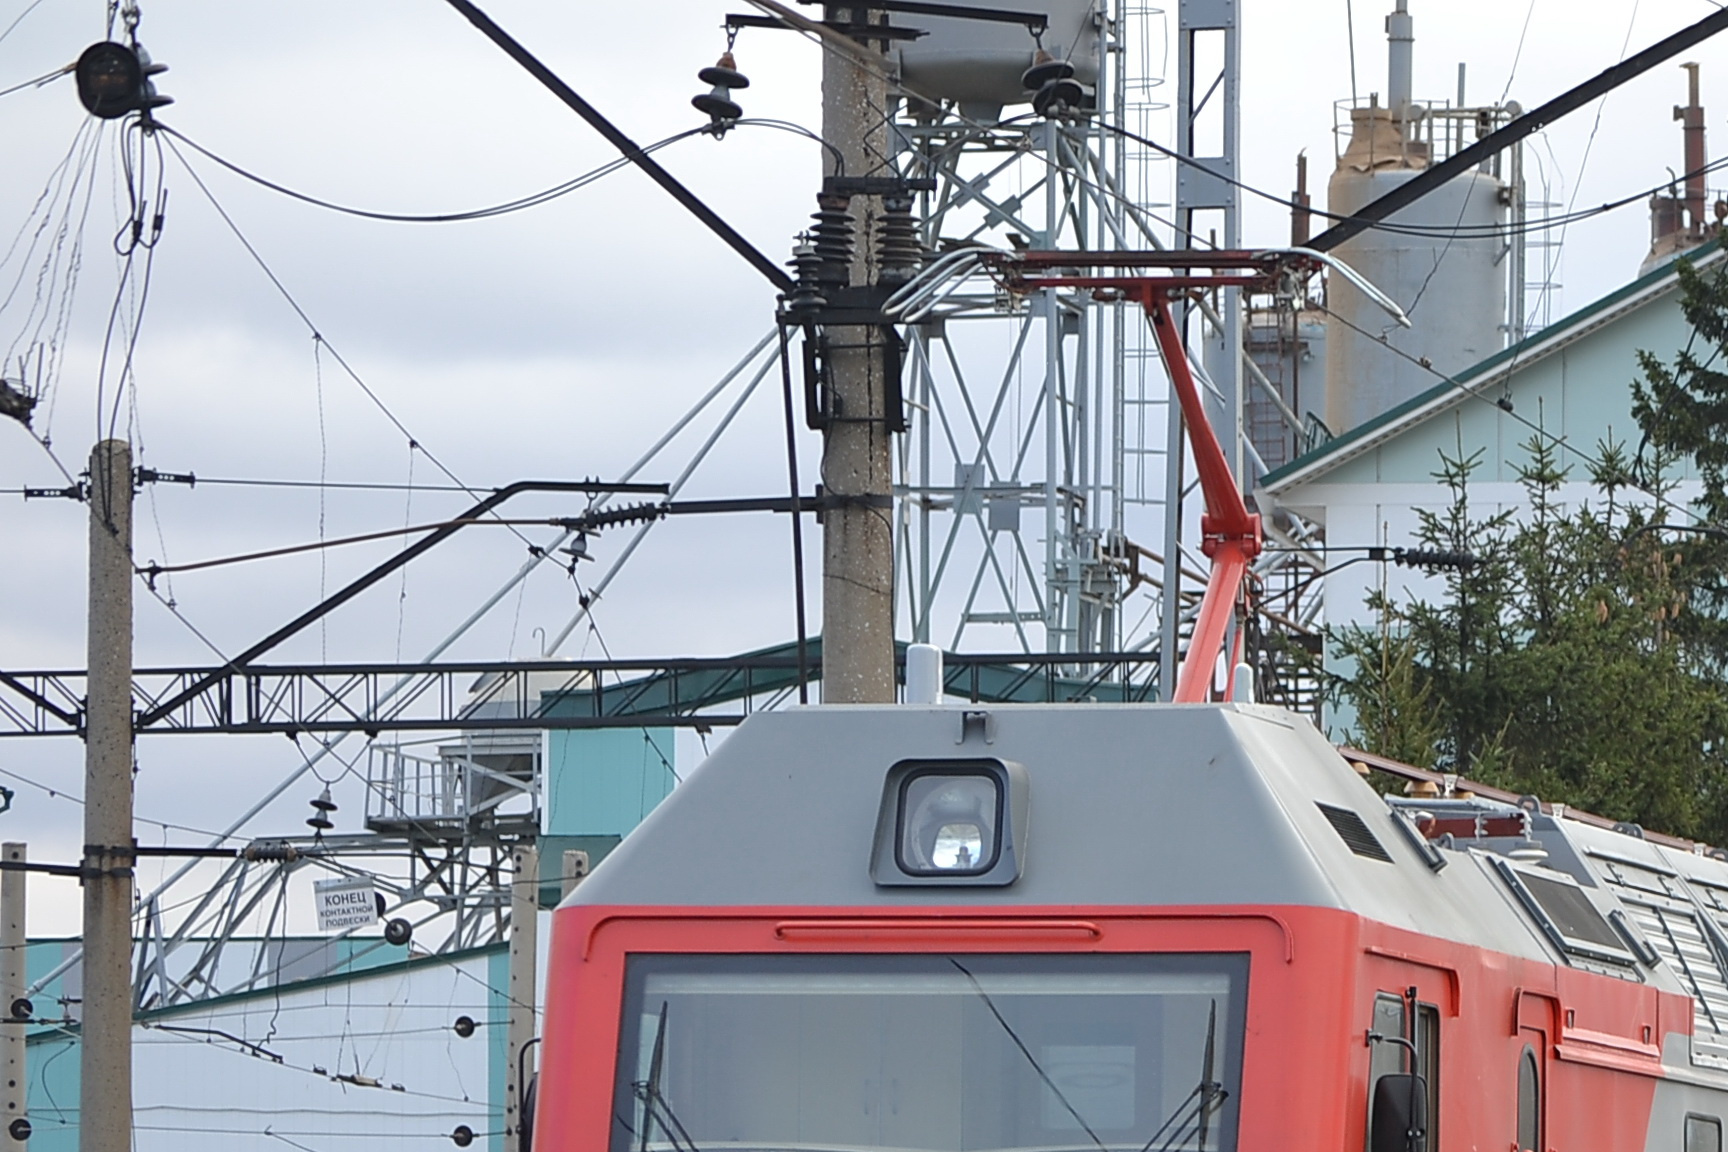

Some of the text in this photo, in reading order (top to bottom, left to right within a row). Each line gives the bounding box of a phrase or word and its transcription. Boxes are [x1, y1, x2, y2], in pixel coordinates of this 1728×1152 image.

[325, 892, 366, 906] КОНЕЦ
[320, 904, 373, 917] КОНТАКТНОЙ
[326, 916, 370, 927] ПОДВЕСКИ
